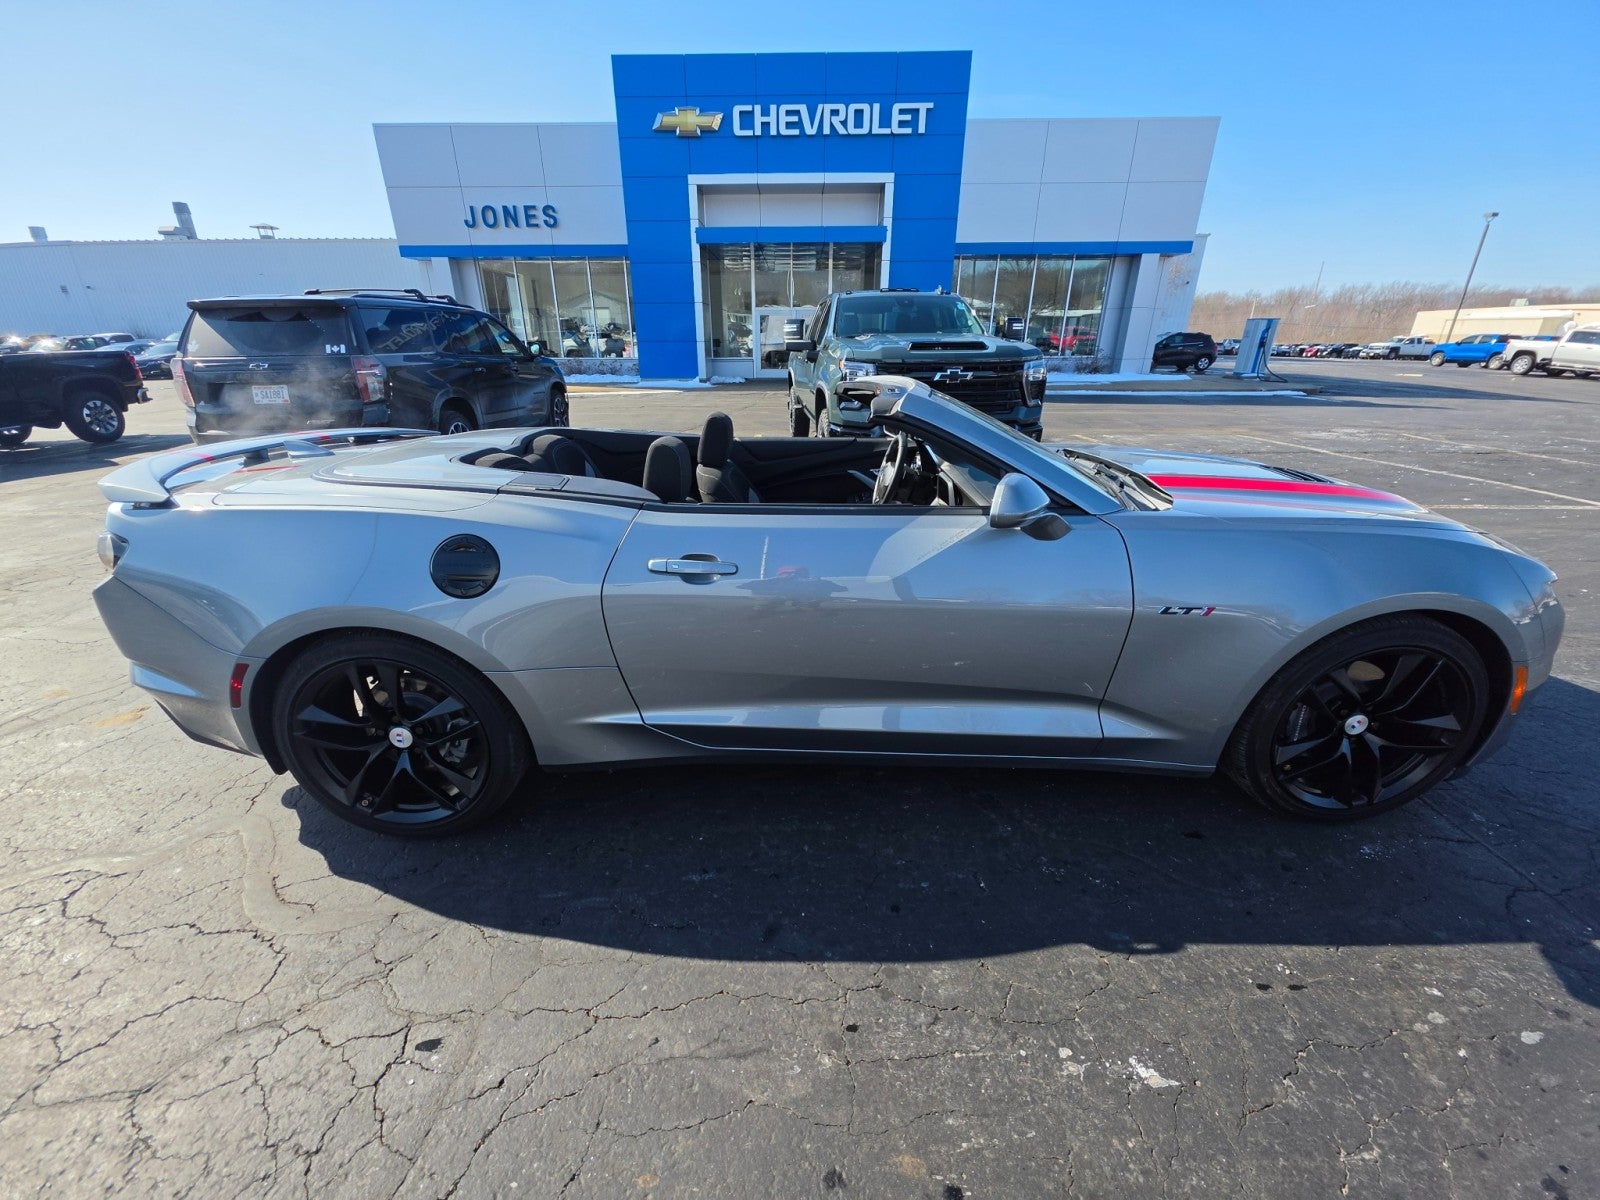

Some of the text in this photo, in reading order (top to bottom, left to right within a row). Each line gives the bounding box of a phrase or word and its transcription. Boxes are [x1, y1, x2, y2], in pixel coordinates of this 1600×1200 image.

[732, 102, 934, 137] CHEVROLET
[463, 204, 558, 229] JONES
[1158, 606, 1217, 617] LT1
